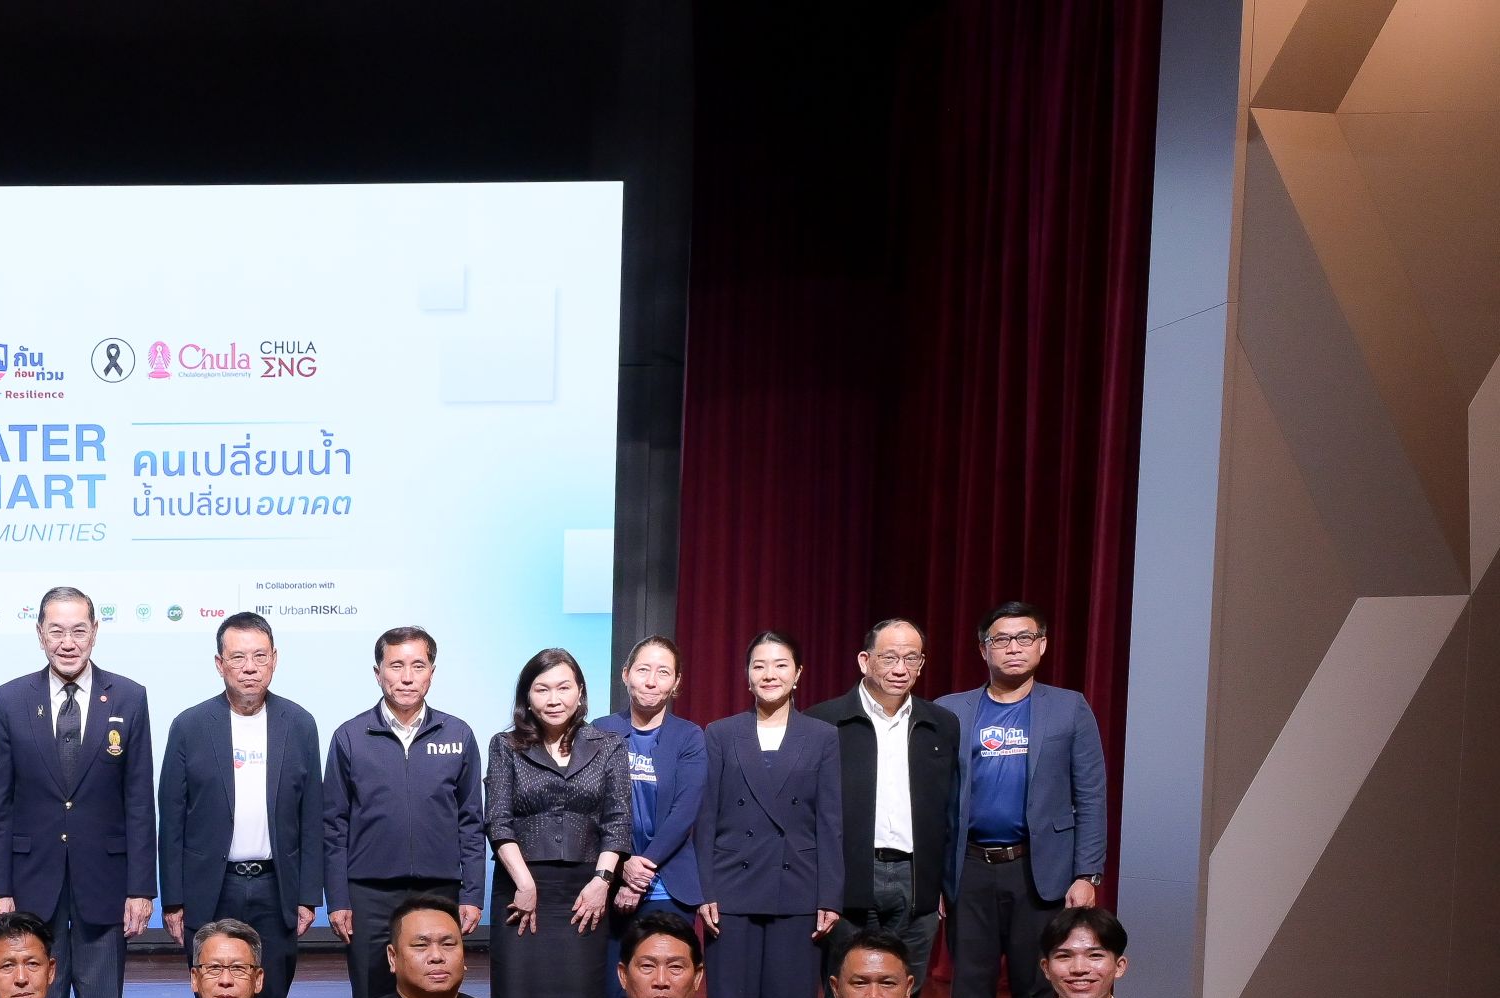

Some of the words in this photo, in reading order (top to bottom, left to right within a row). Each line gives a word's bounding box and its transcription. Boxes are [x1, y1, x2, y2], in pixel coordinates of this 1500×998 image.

[260, 341, 317, 354] CHULA
[14, 345, 44, 367] กัน
[178, 342, 252, 370] Chula
[178, 371, 221, 379] Chulalongkorn
[222, 371, 251, 379] University
[5, 389, 65, 399] Resilience
[132, 428, 352, 477] คนเปลี่ยนน้ำ
[256, 581, 263, 590] In
[265, 581, 317, 590] Collaboration
[318, 581, 335, 590] with
[200, 607, 225, 618] true
[279, 604, 358, 615] UrbanRISKLab
[426, 742, 463, 755] กทม
